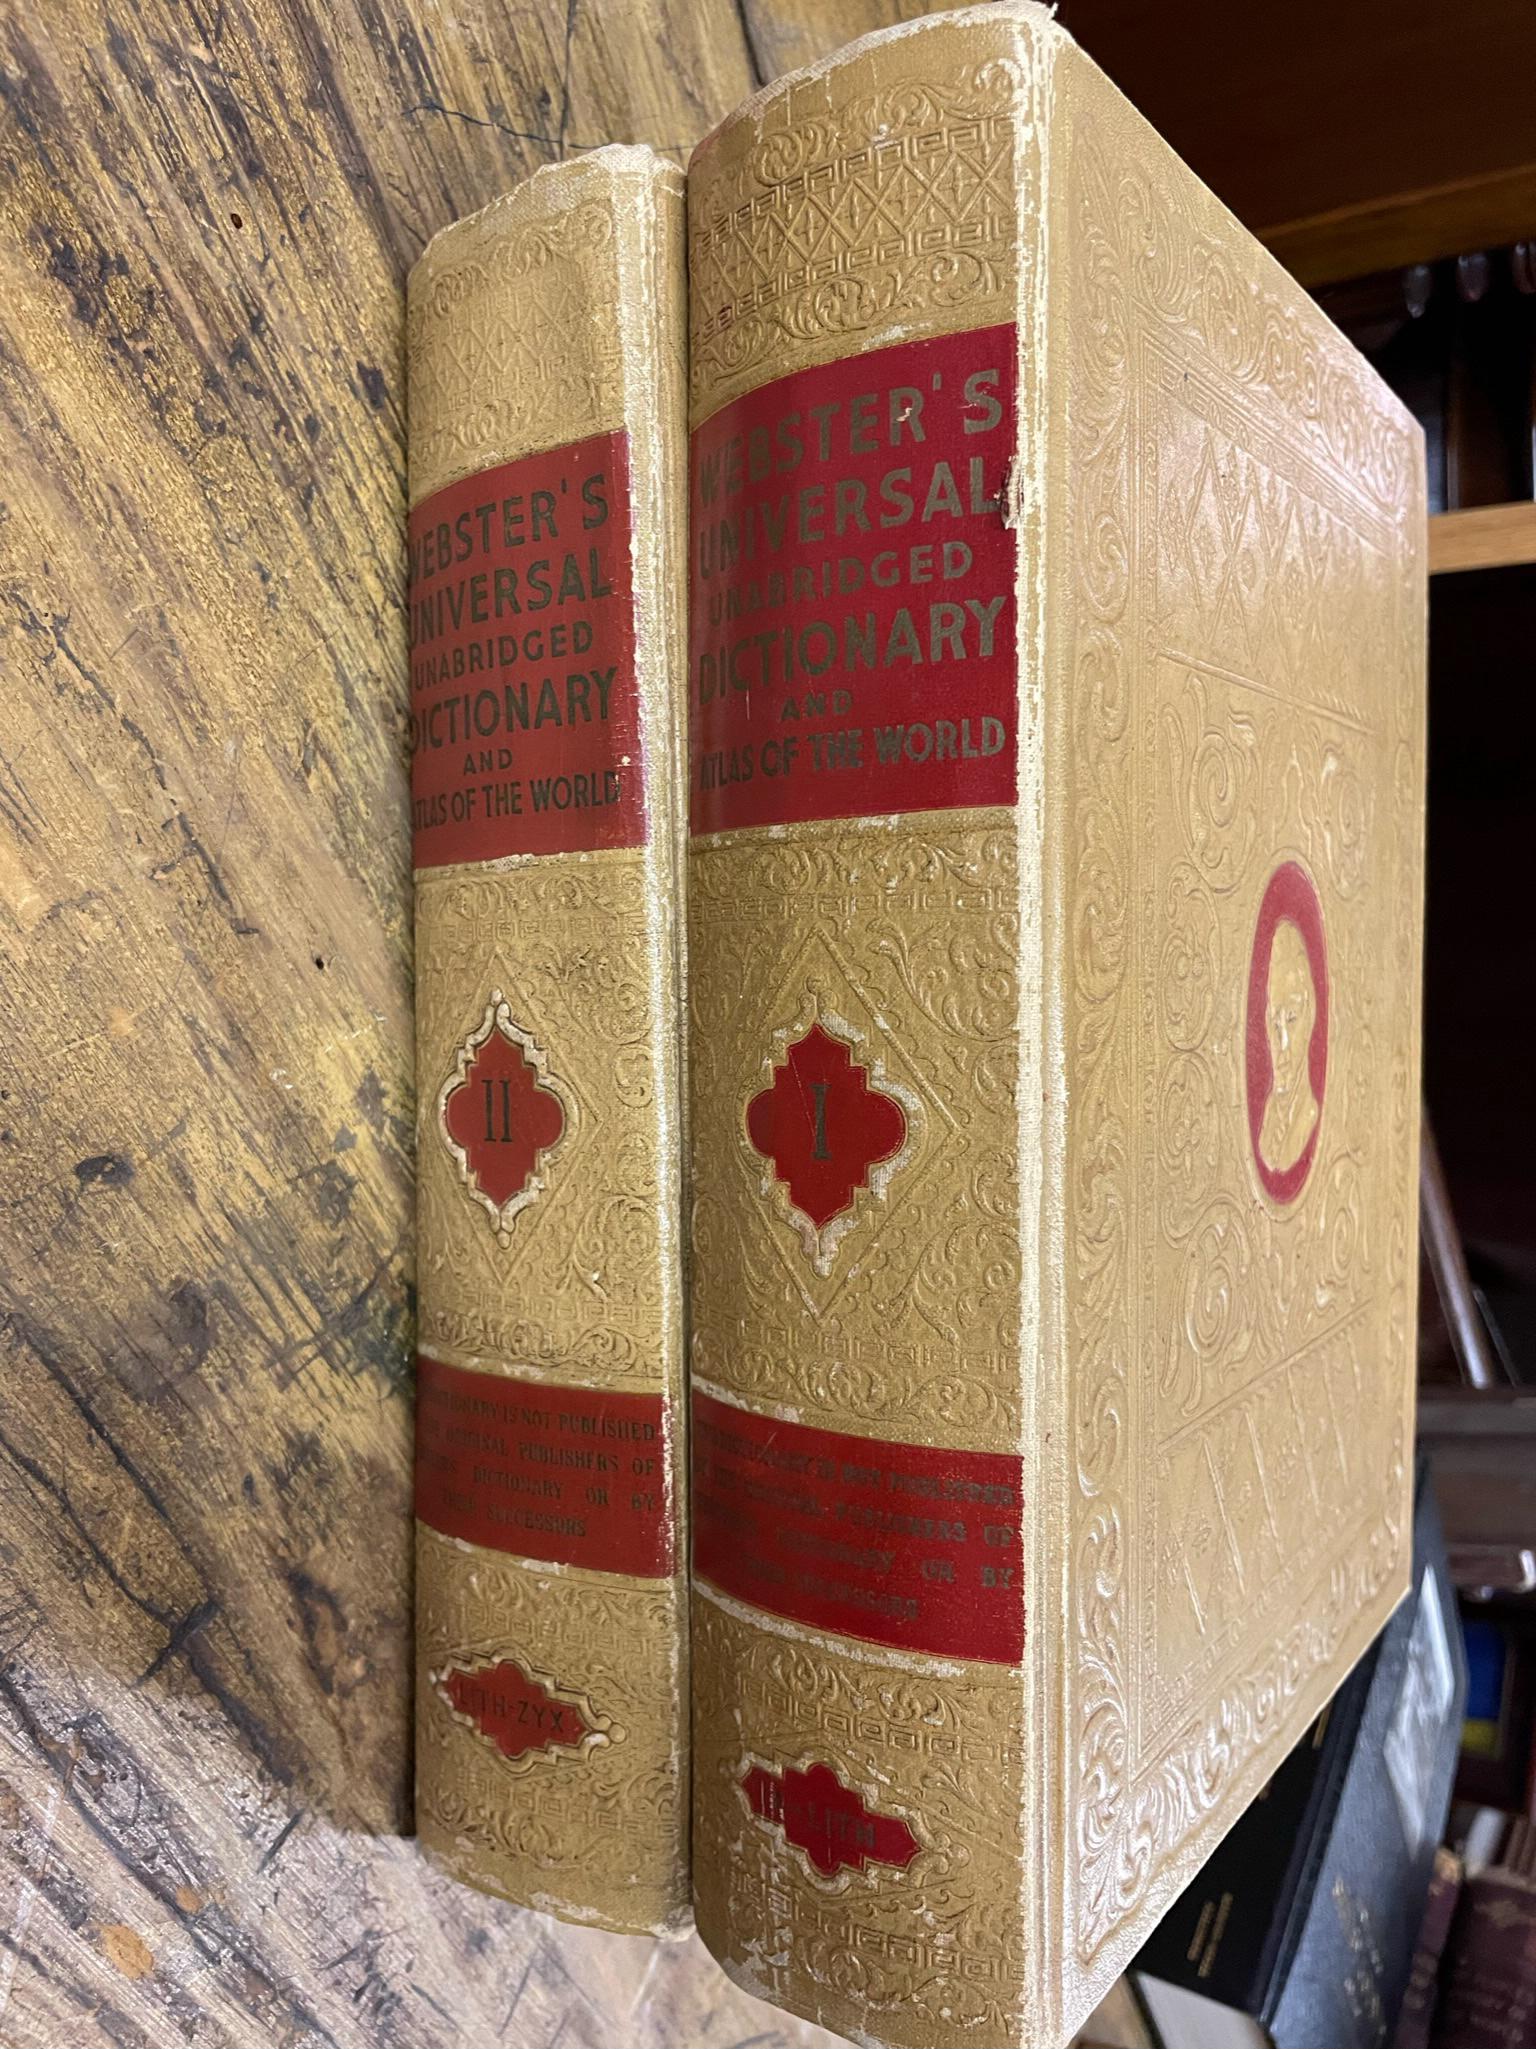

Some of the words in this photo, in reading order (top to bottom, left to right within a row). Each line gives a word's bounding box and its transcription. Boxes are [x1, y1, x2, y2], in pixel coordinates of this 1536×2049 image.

[700, 369, 1002, 507] WEBSTER'S
[700, 457, 1000, 580] UNIVERSAL
[708, 540, 974, 628] UNABRIDGED
[414, 620, 594, 692] UNABRIDGED
[699, 596, 1007, 705] DICTIONARY
[410, 666, 619, 754] DICTIONARY
[780, 689, 852, 721] AND
[463, 747, 513, 776] AND
[701, 743, 754, 790] ATLAS
[760, 736, 800, 777] OF
[807, 728, 864, 772] THE
[873, 716, 1006, 764] WORLD
[452, 787, 477, 823] OF
[483, 780, 524, 818] THE
[529, 770, 622, 813] WORLD
[482, 1079, 513, 1142] II
[810, 1083, 832, 1160] I
[522, 1408, 551, 1430] NOT
[559, 1412, 655, 1441] PUBLISHED
[473, 1464, 562, 1498] DICTIONARY
[585, 1487, 609, 1506] OR
[631, 1491, 656, 1512] BY
[519, 1442, 619, 1472] PUBLISHERS
[632, 1457, 656, 1476] OF
[980, 1564, 1015, 1590] BY
